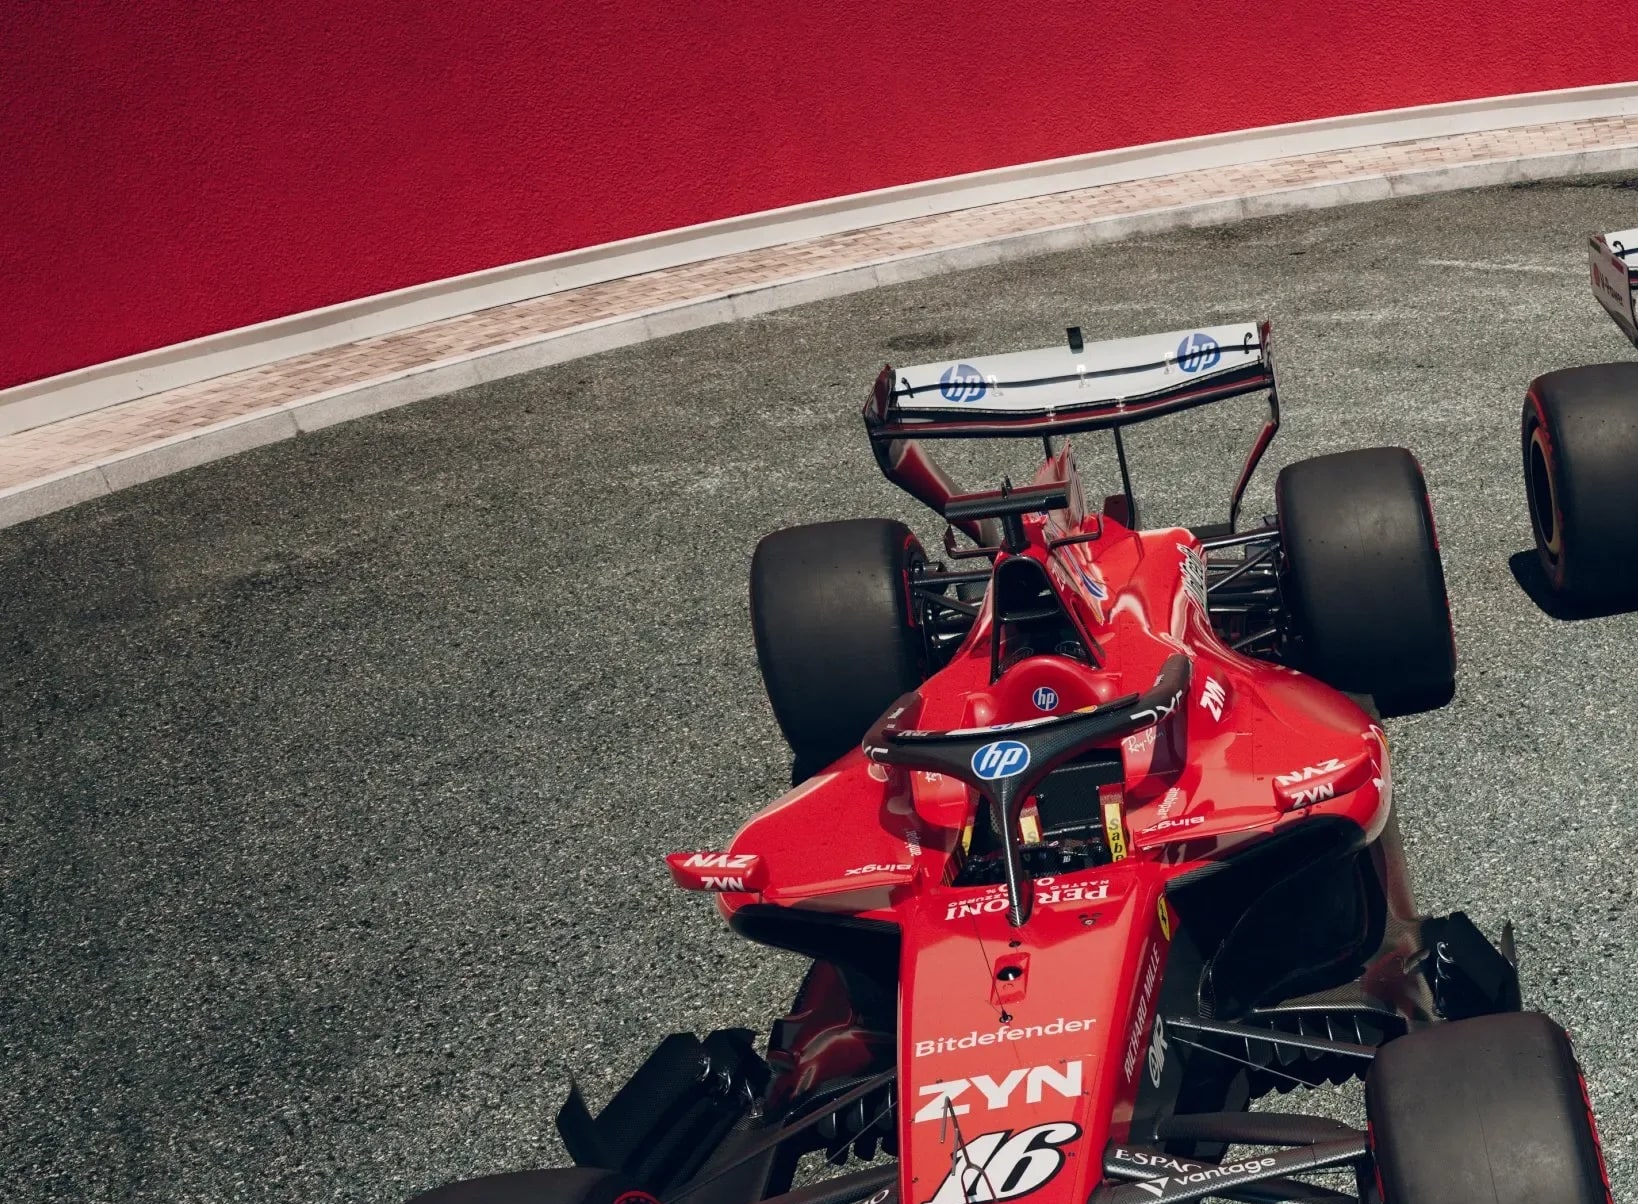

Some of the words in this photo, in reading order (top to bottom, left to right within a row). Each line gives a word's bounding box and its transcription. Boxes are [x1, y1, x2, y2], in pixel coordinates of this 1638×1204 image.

[1178, 333, 1221, 373] hp
[941, 364, 986, 403] hp
[1033, 687, 1059, 711] hp
[1200, 675, 1226, 723] ZYN
[971, 740, 1030, 780] hp
[1275, 758, 1347, 787] ZYN
[1290, 782, 1335, 809] ZYN
[683, 854, 759, 868] ZYN
[700, 876, 745, 891] ZYN
[944, 884, 1109, 921] PERONI
[1123, 995, 1148, 1084] RICHARD
[1143, 942, 1161, 1002] MILLE
[914, 1016, 1097, 1058] Bitdefender
[914, 1060, 1083, 1123] ZYN
[1174, 1157, 1276, 1186] vantage
